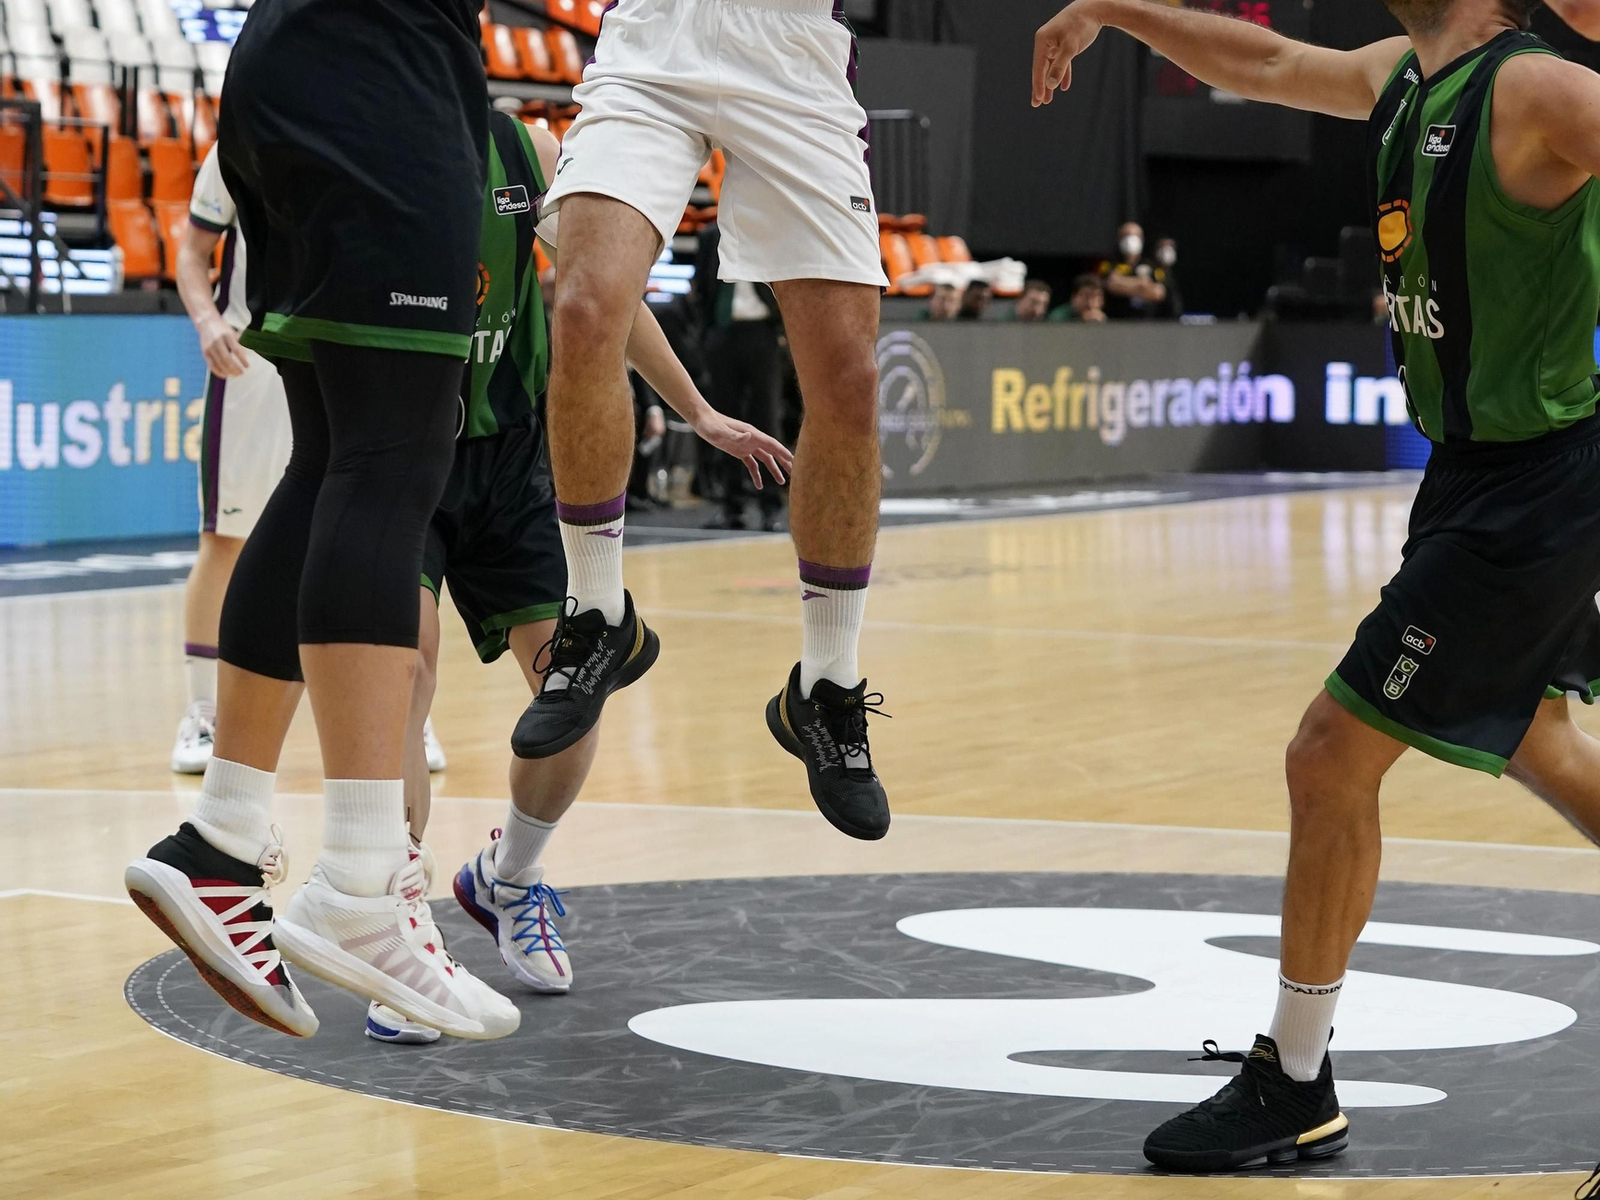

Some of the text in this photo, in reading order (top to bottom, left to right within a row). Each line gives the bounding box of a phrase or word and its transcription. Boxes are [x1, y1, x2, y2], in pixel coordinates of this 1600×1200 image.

[1428, 133, 1442, 145] liga
[498, 200, 527, 212] endesa
[389, 291, 448, 311] SPALDING
[991, 360, 1411, 447] Refrigeración in
[1405, 634, 1426, 649] acb
